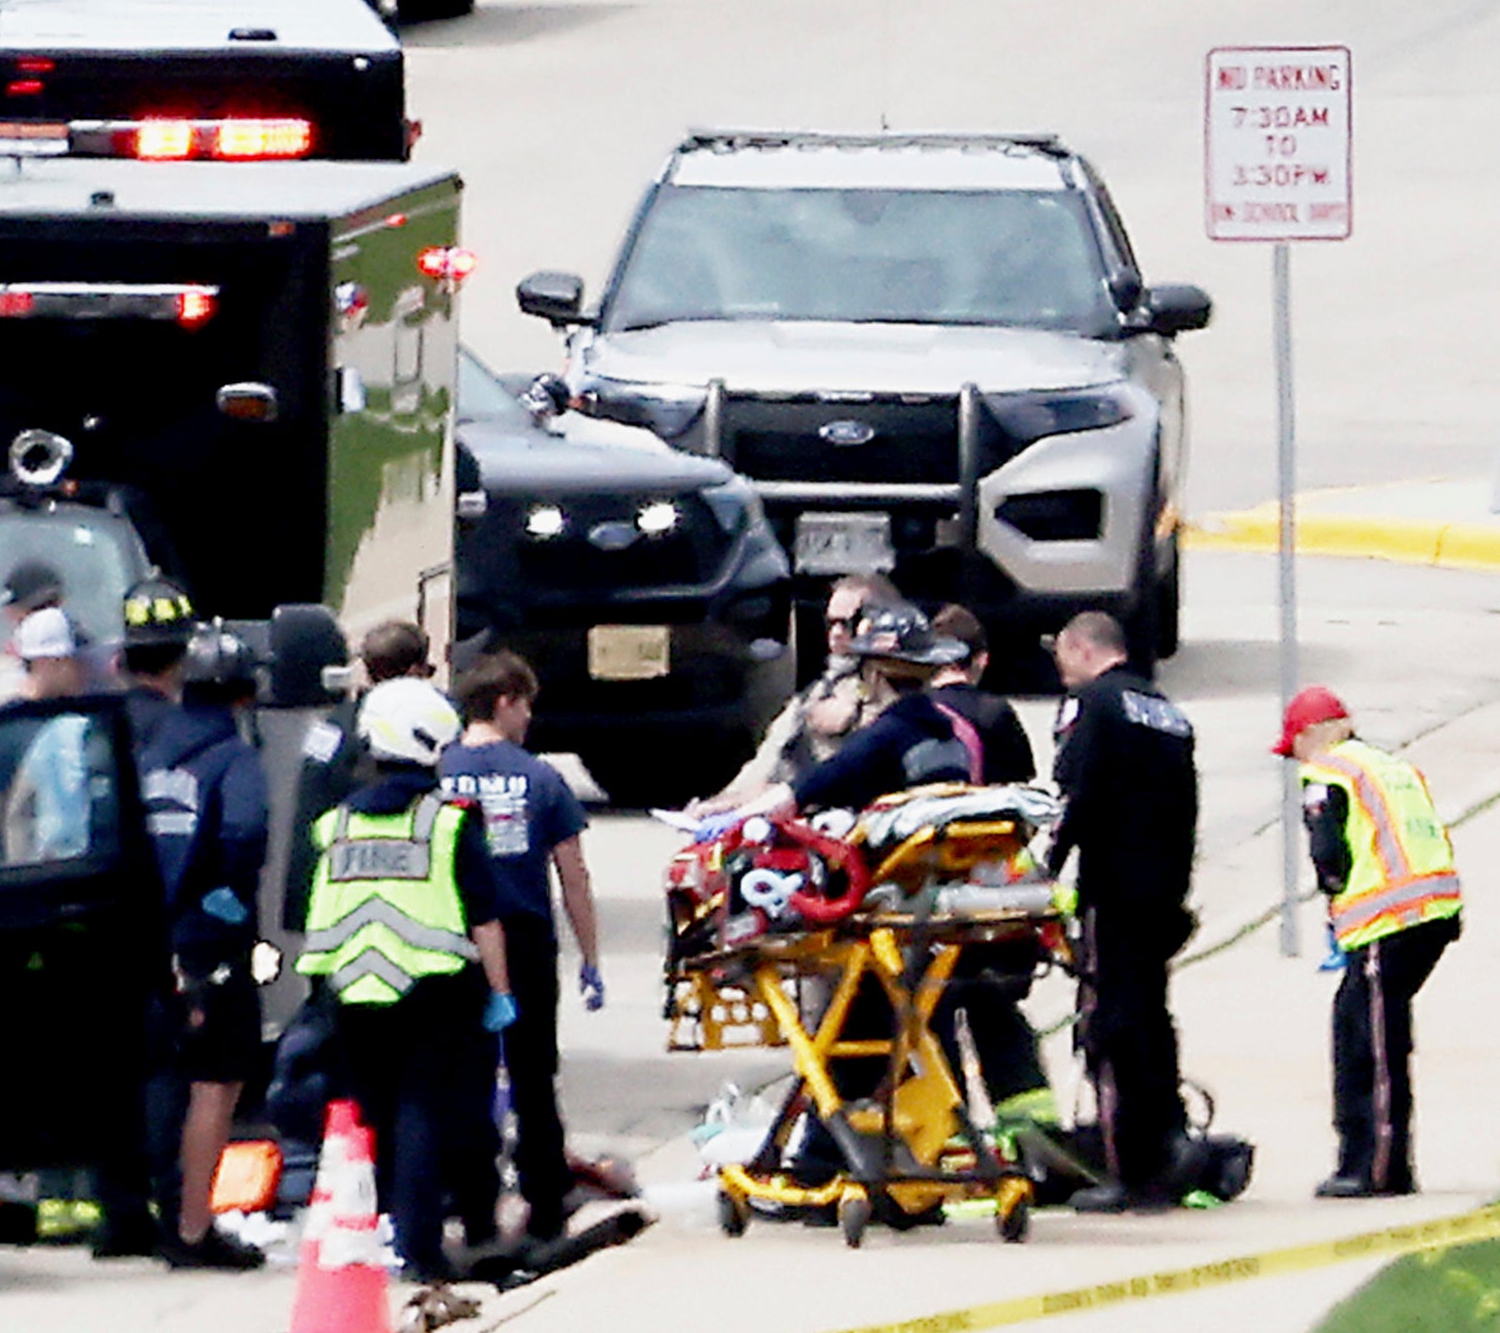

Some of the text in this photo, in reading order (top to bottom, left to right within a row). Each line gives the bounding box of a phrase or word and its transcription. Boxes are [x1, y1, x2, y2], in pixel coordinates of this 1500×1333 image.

[1254, 64, 1340, 92] PARKING
[1230, 105, 1330, 128] 7:30AM
[1265, 134, 1298, 157] TO
